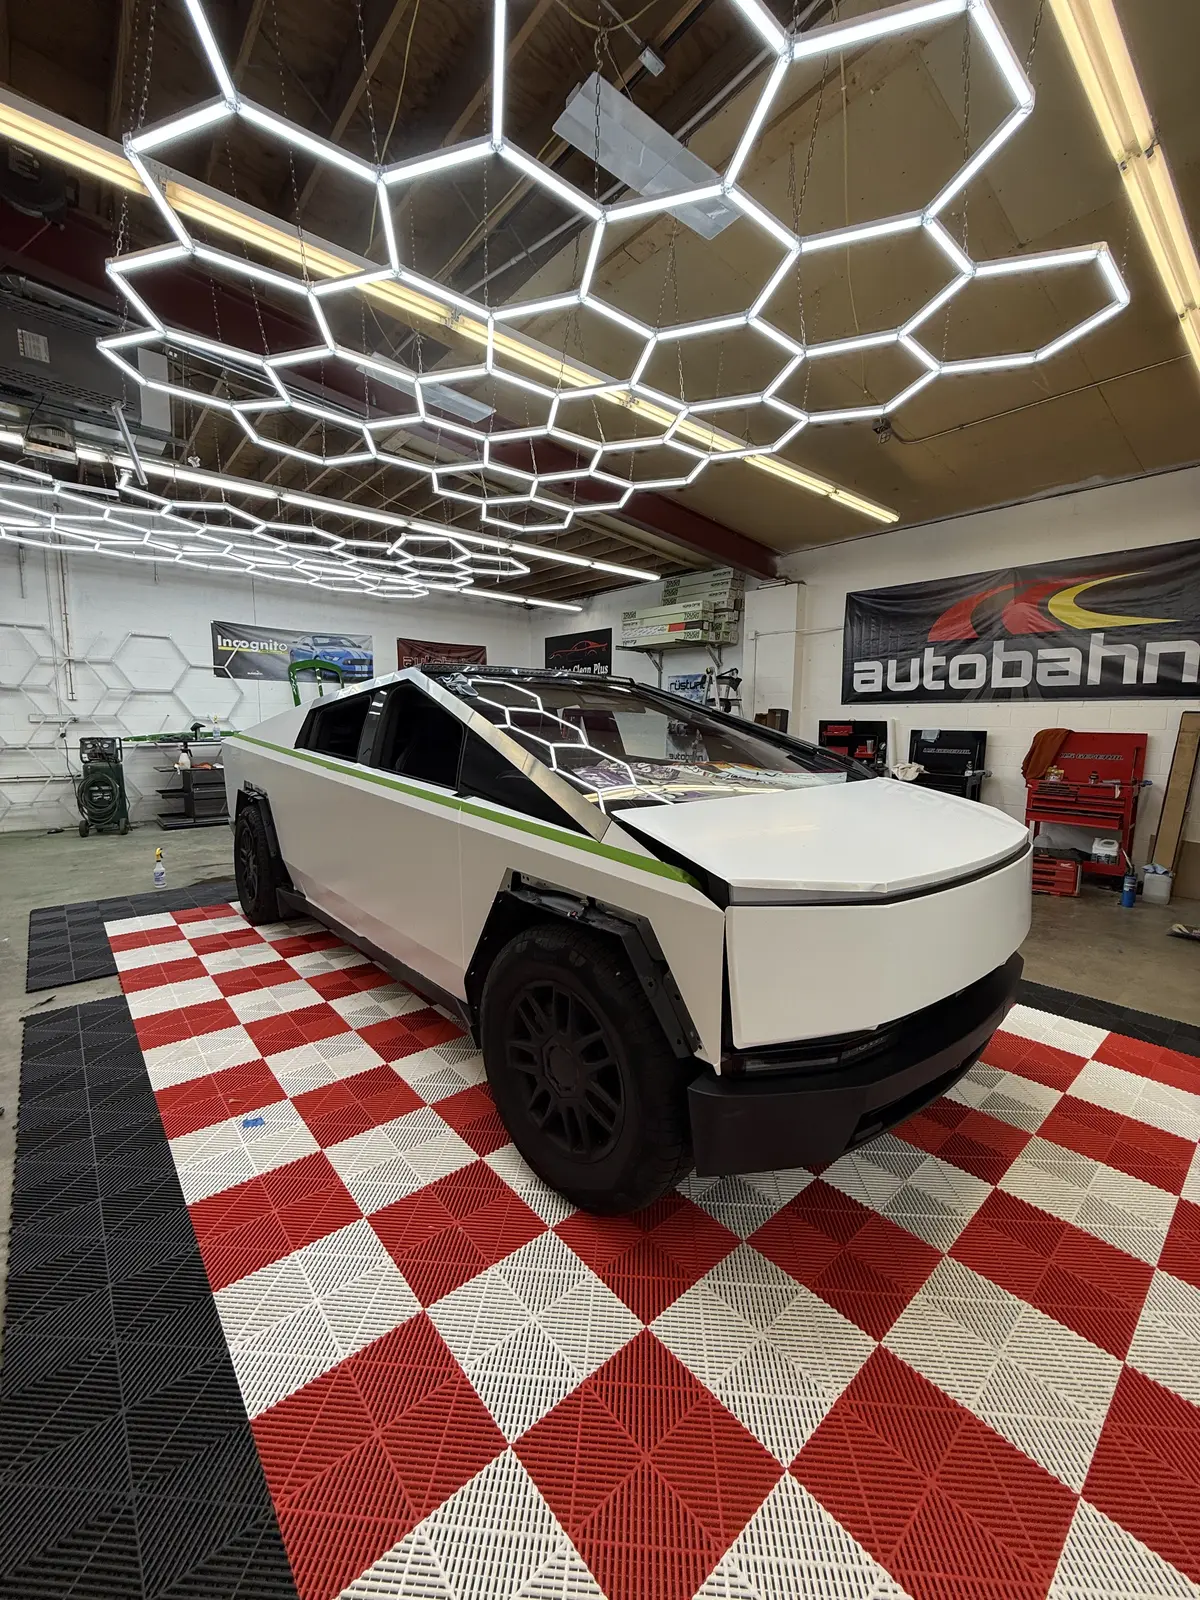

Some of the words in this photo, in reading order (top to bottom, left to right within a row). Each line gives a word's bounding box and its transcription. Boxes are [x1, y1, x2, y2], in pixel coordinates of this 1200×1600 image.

[217, 634, 288, 652] Incognito
[593, 662, 609, 675] Plus
[853, 632, 1200, 693] autobahn
[669, 679, 706, 691] rüstun
